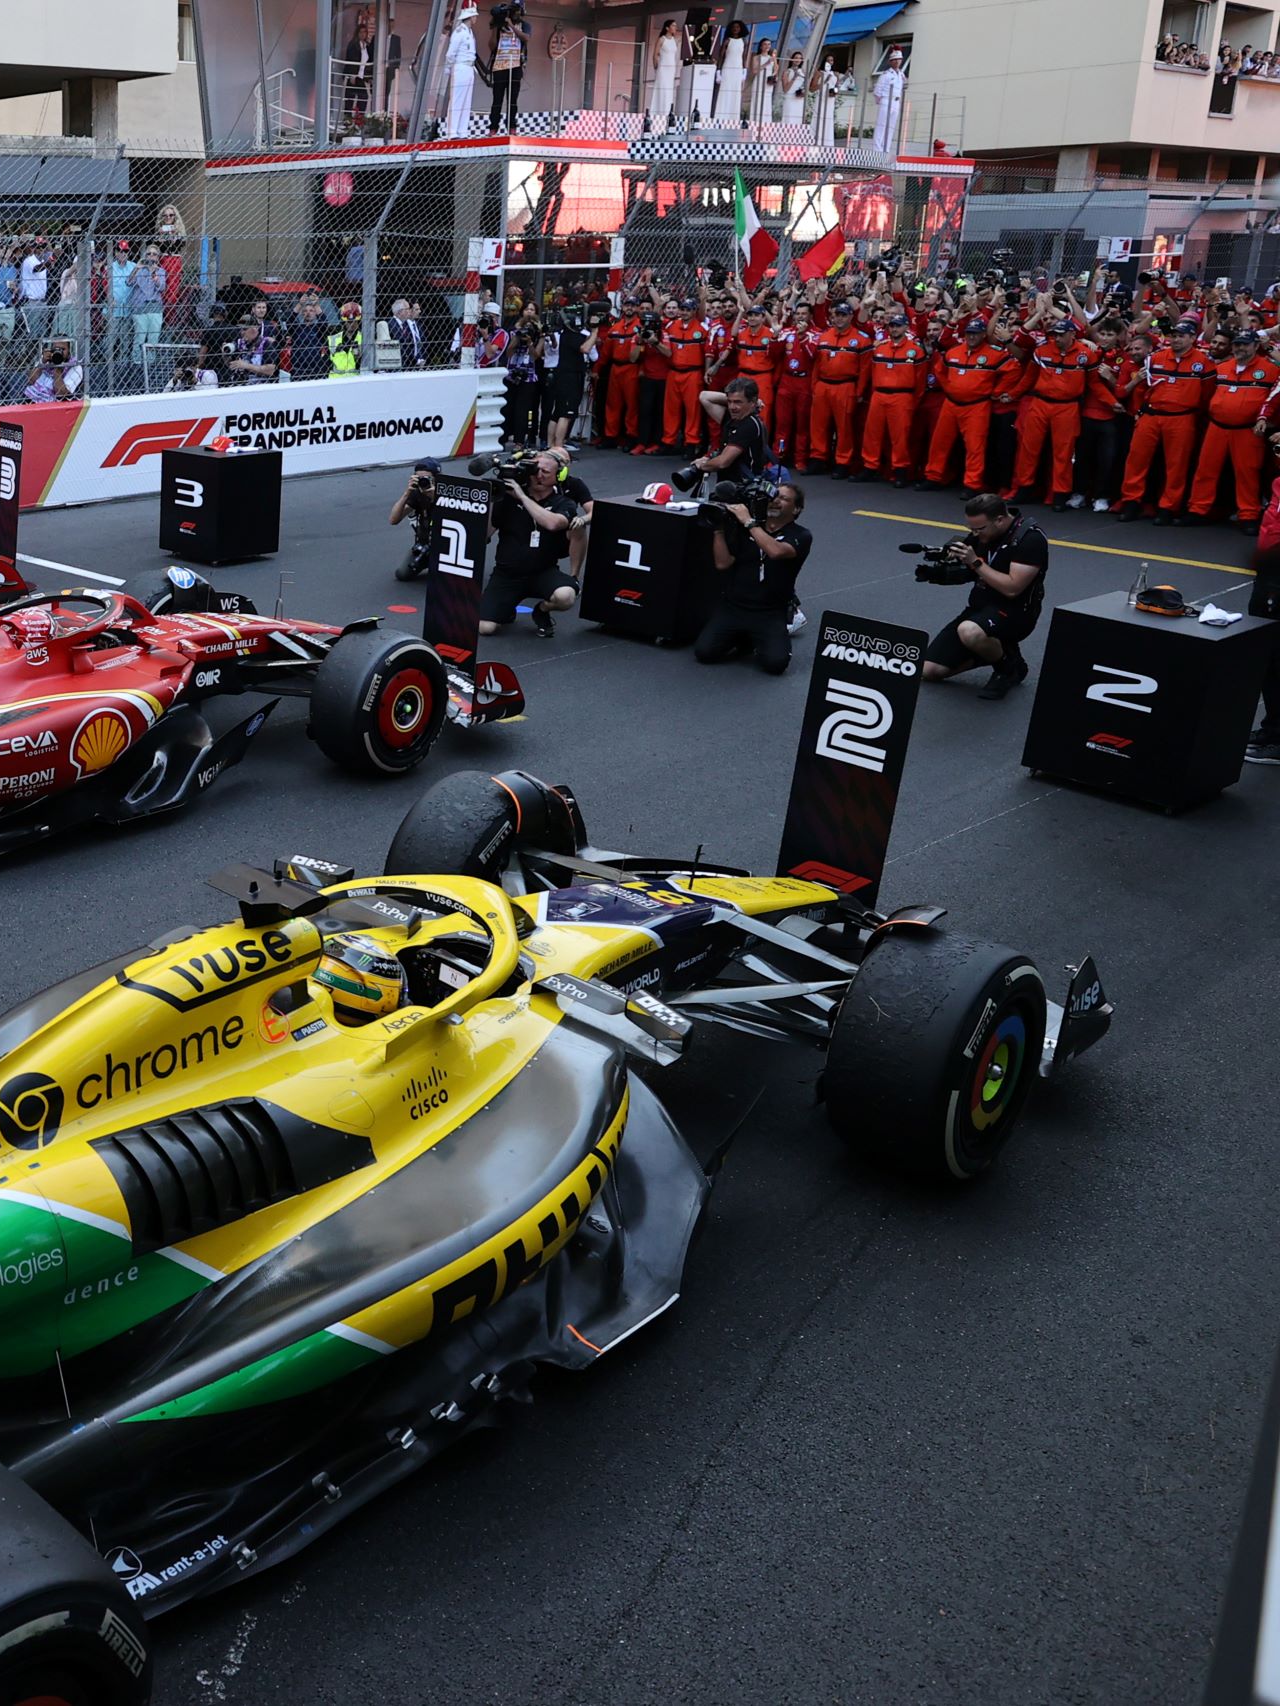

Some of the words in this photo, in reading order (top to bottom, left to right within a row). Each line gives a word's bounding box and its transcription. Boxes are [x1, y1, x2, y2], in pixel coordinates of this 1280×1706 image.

[225, 407, 324, 434] FORMULA
[0, 438, 22, 452] MONACO
[175, 477, 204, 508] 3
[436, 496, 488, 515] MONACO
[437, 482, 469, 499] RACE
[470, 487, 489, 502] 08
[438, 518, 475, 579] 1
[615, 538, 652, 572] 1
[26, 647, 48, 660] aws
[204, 642, 233, 654] CHARD
[235, 637, 259, 649] MILLE
[823, 626, 892, 655] ROUND
[892, 642, 920, 661] 08
[821, 643, 917, 677] MONACO
[362, 672, 383, 711] PIRELLI
[1086, 664, 1159, 714] 2
[815, 678, 894, 773] 2
[25, 745, 59, 758] LOGISTICS
[372, 901, 409, 921] FxPro
[599, 952, 631, 977] RICHARD
[631, 942, 654, 960] MILLE
[674, 950, 708, 973] McLaren
[544, 976, 588, 999] FxPro
[627, 967, 661, 993] WORLD
[301, 1018, 327, 1037] PIASTRI
[76, 1014, 244, 1110] chrome
[160, 1534, 229, 1582] rent-a-jet
[99, 1607, 147, 1679] PIRELLI
